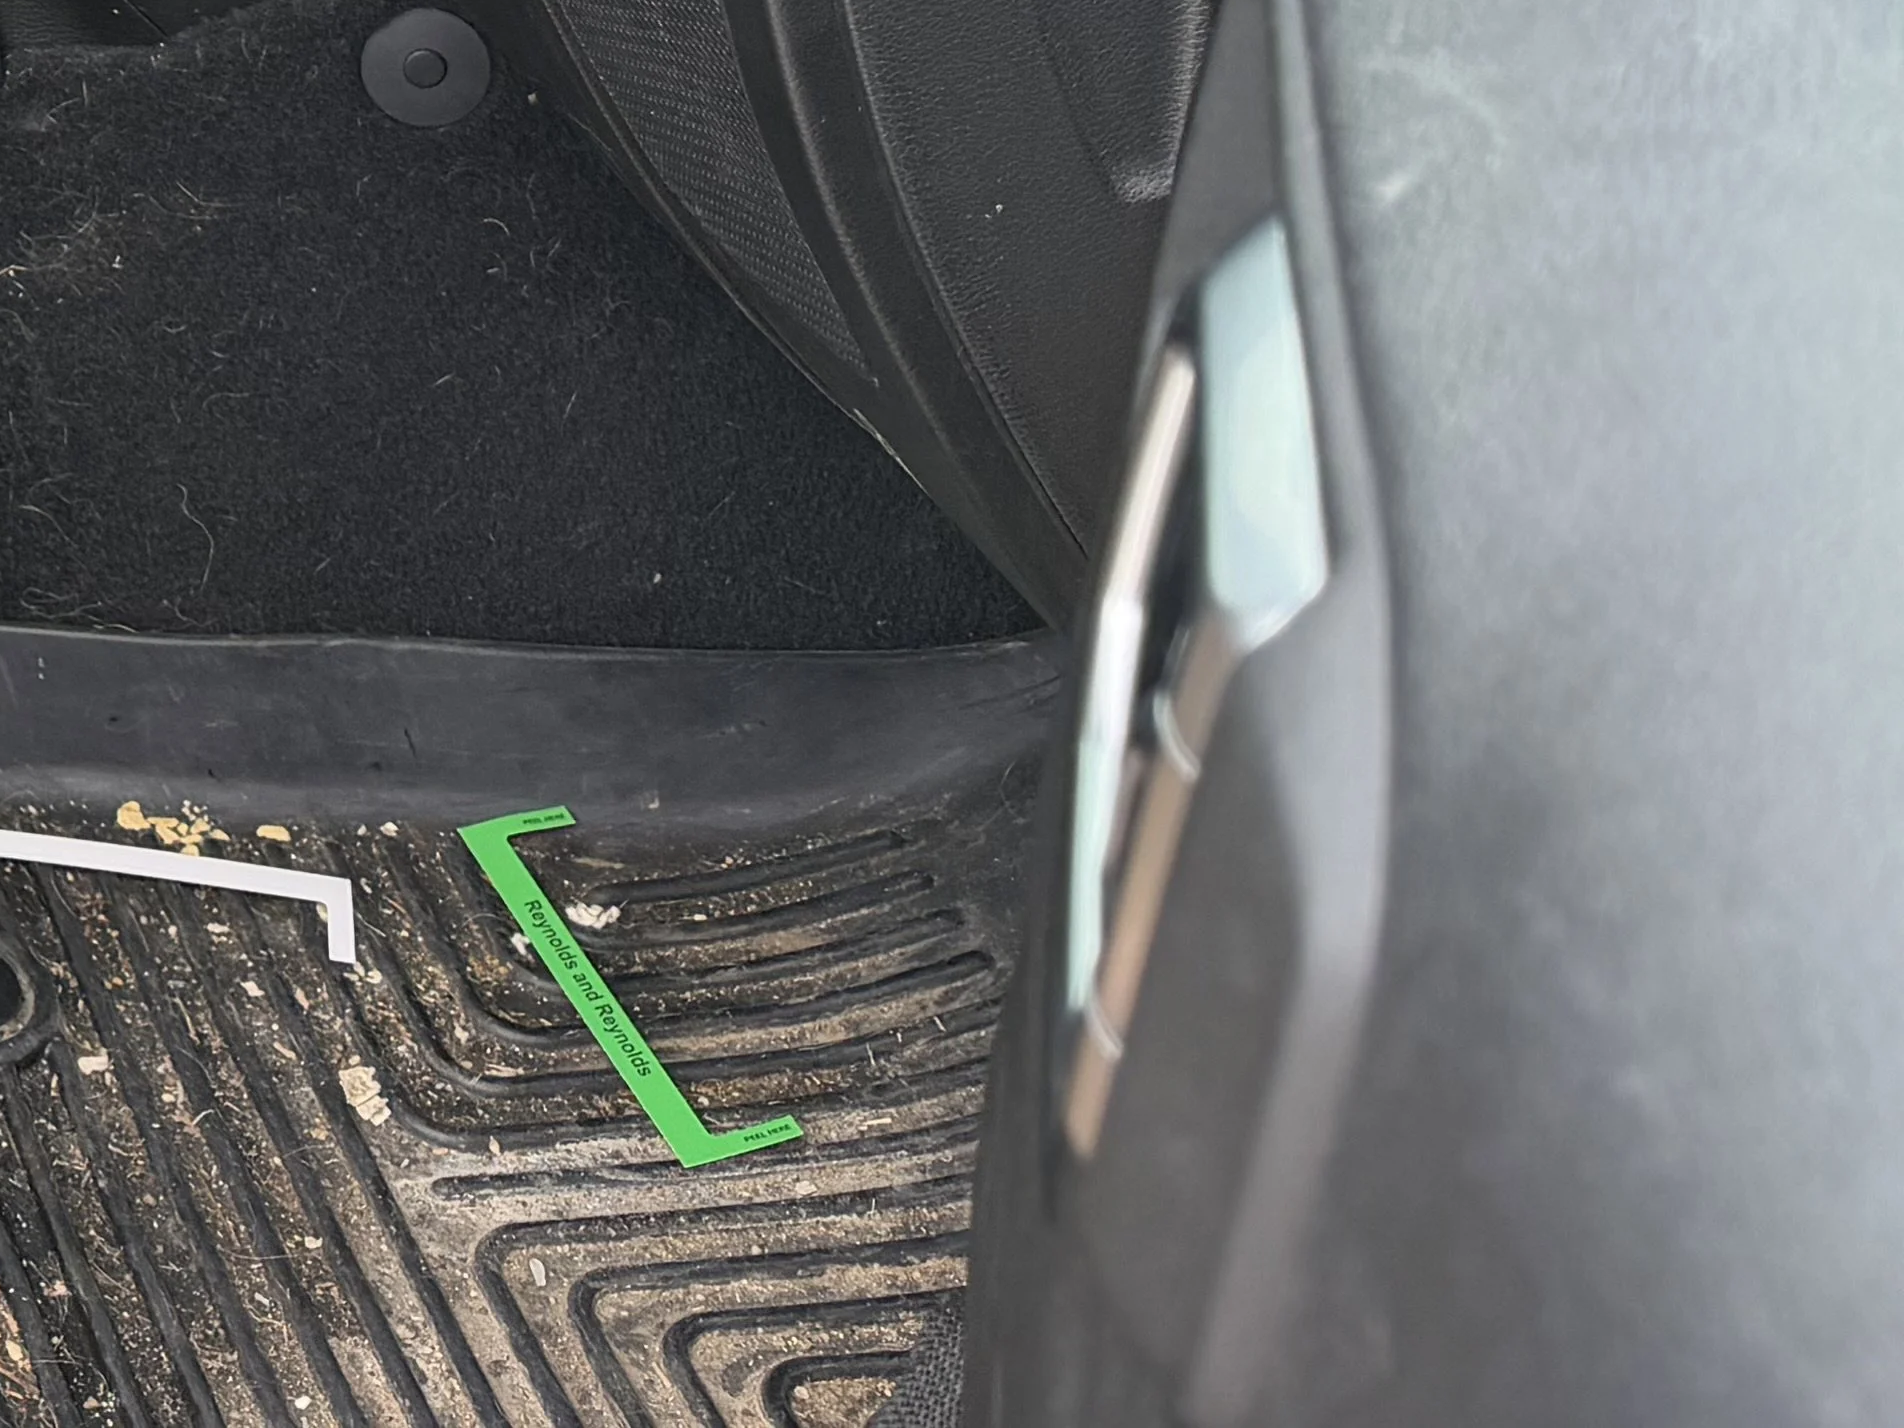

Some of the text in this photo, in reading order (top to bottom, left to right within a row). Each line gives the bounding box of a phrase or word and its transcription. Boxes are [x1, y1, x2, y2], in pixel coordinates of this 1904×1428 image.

[524, 898, 652, 1078] Reynolds and Reynolds
